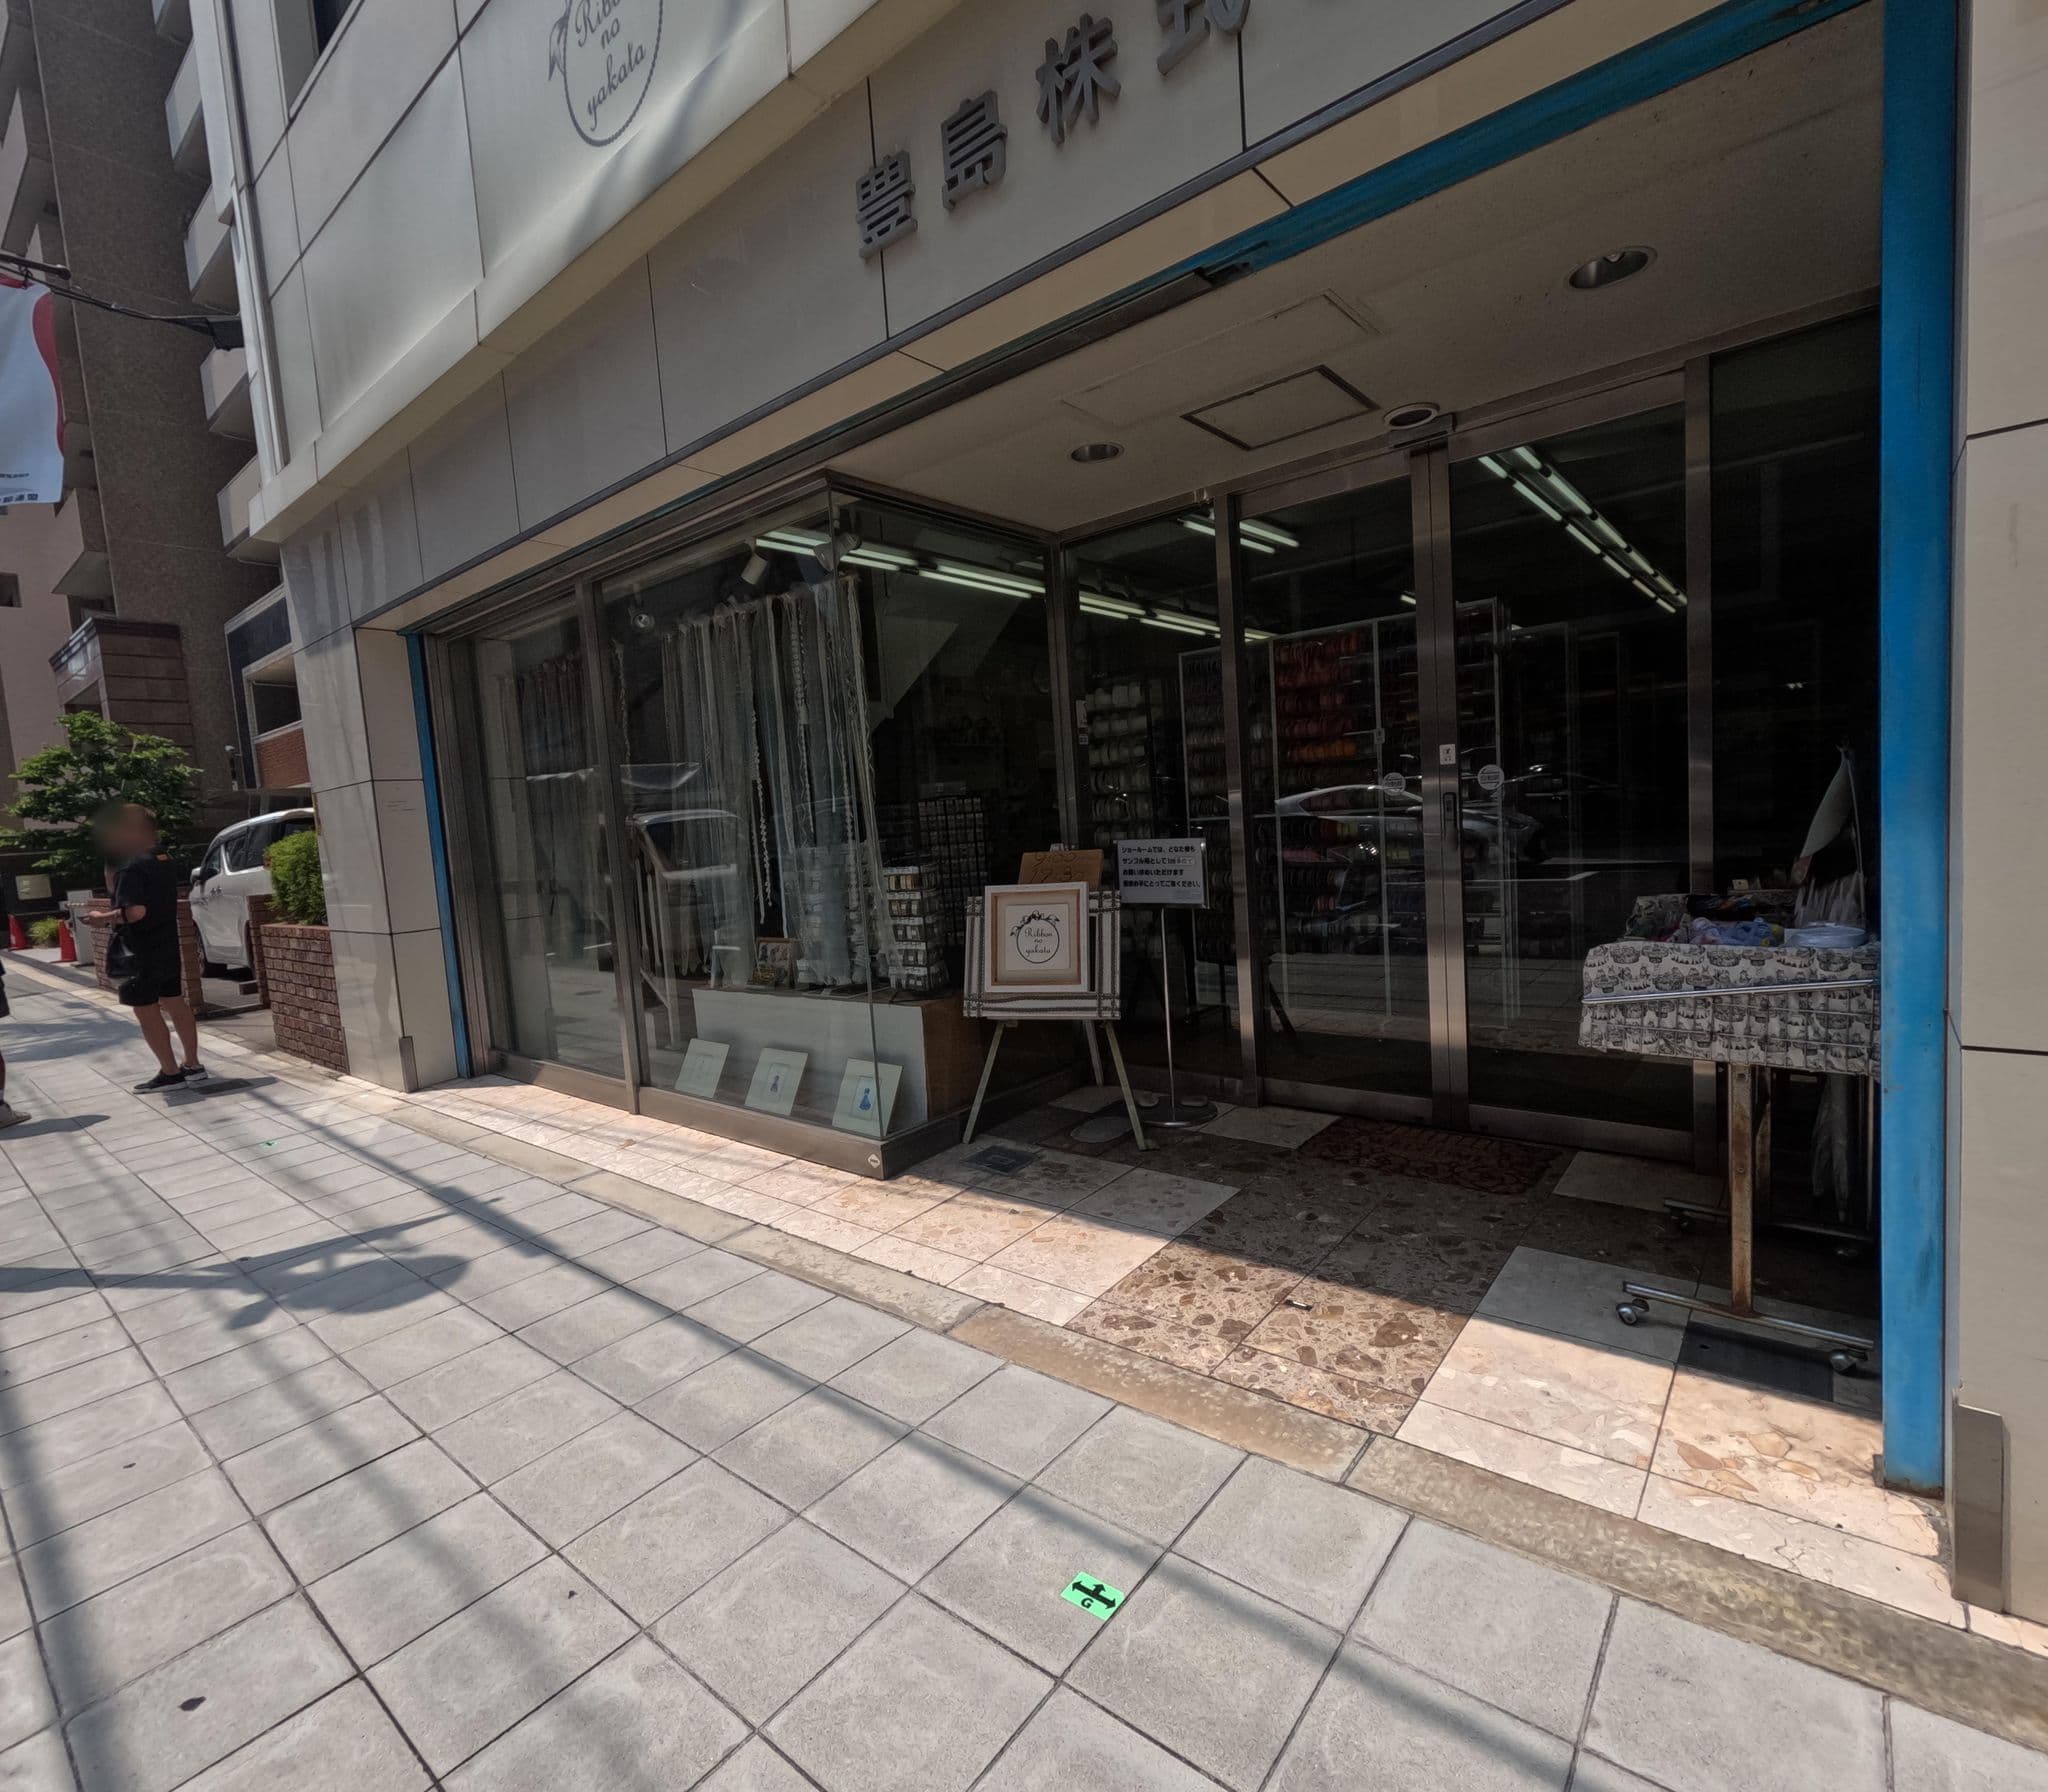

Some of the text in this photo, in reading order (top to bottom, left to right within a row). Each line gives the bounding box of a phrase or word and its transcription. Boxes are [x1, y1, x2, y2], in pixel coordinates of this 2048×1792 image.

[600, 18, 620, 50] no
[587, 42, 646, 132] yakata
[1024, 927, 1053, 937] Ribbon
[1081, 1597, 1094, 1609] G
